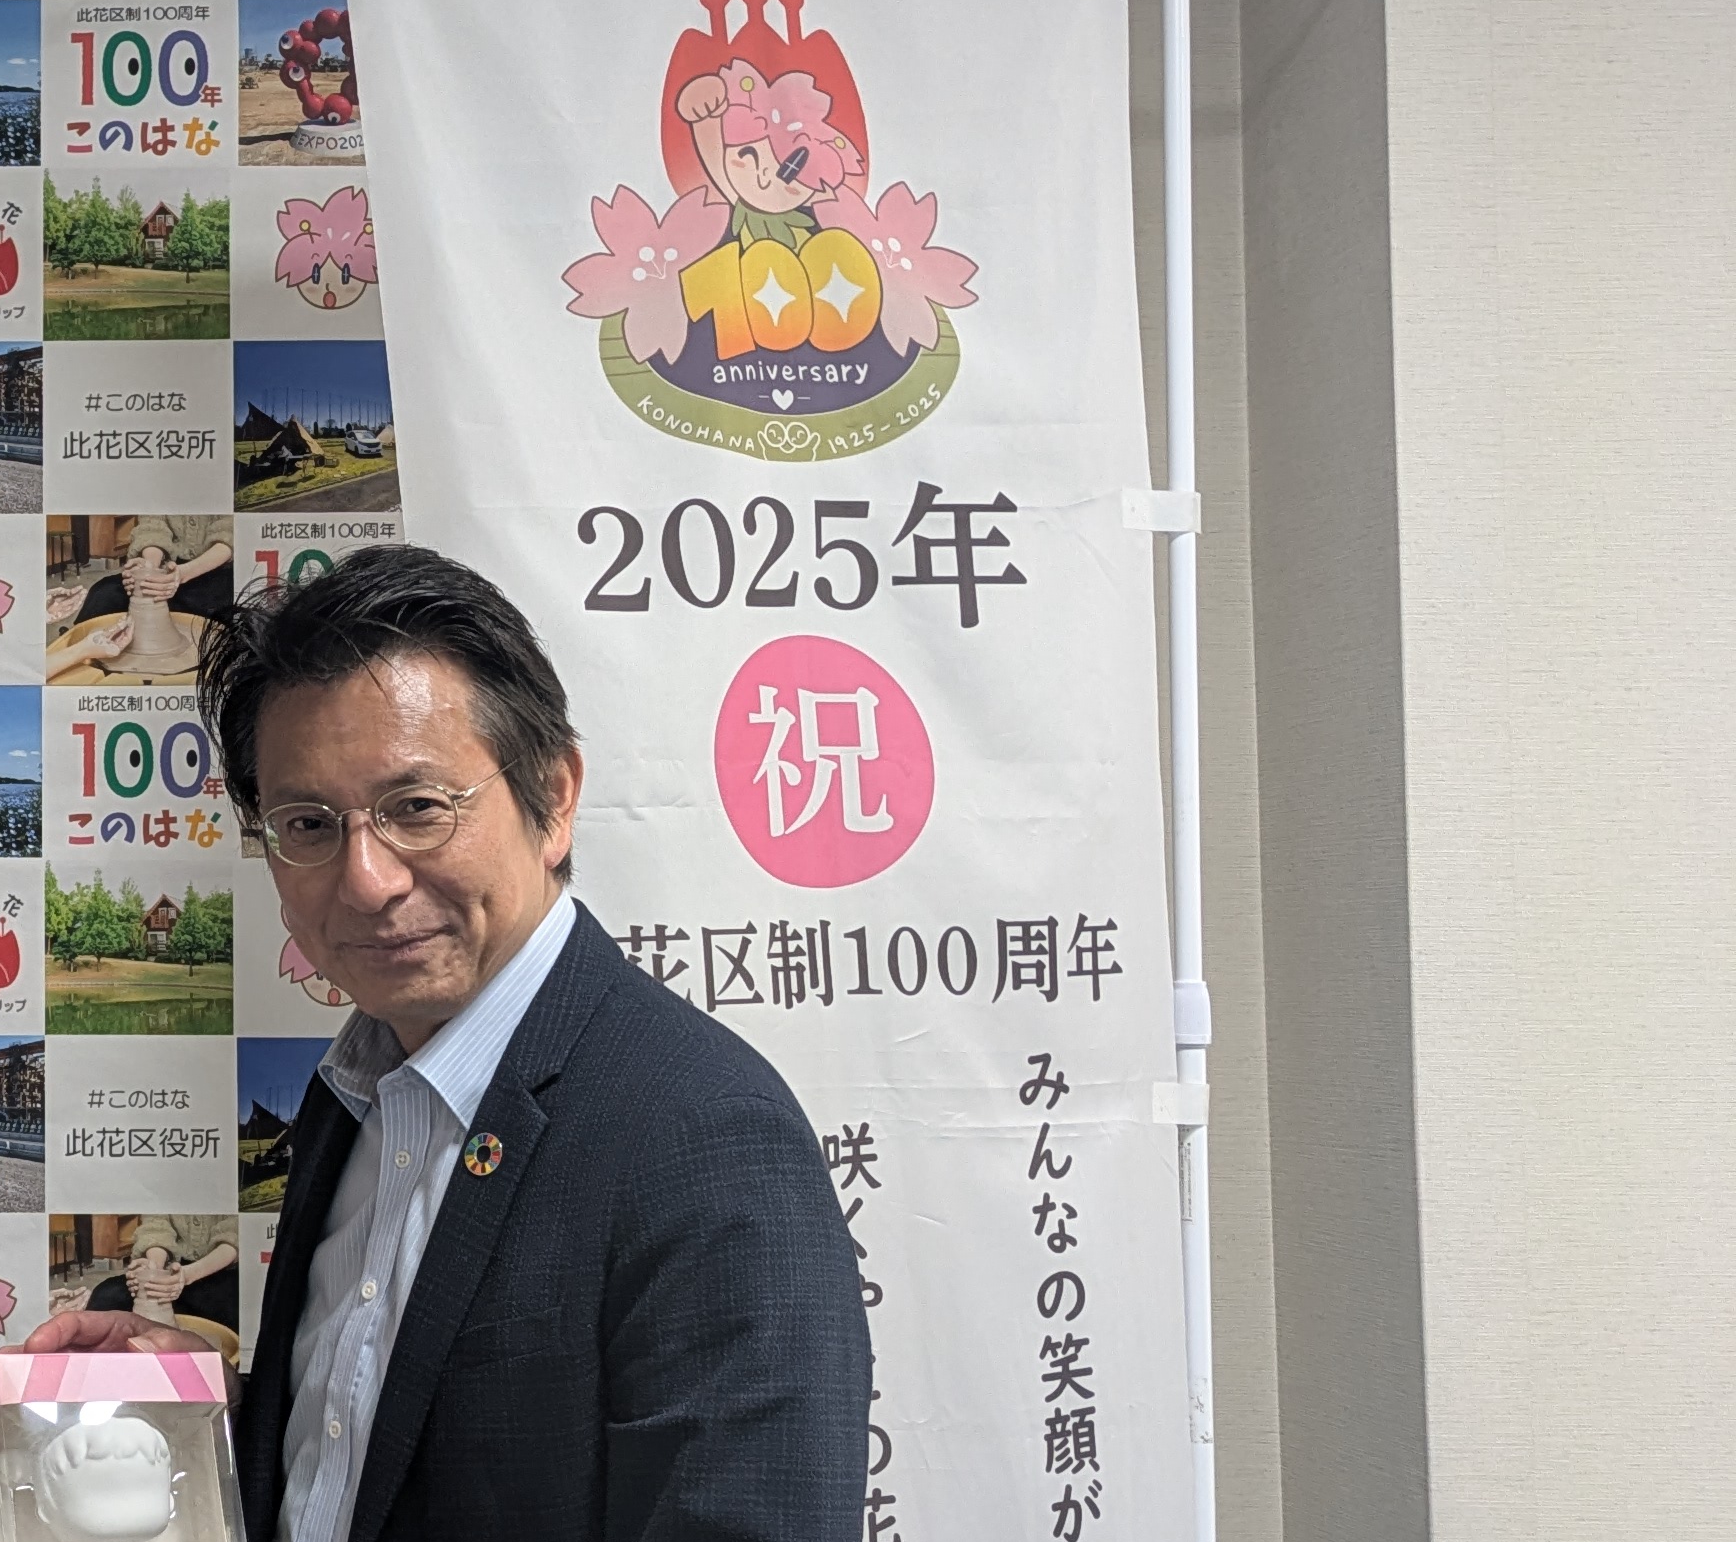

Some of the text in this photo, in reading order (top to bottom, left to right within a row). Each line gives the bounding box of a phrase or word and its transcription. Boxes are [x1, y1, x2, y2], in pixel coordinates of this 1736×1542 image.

[76, 6, 211, 23] 此花区制100周年
[66, 116, 221, 157] このはな
[678, 227, 884, 361] 100
[712, 359, 870, 385] anniversary
[84, 391, 188, 413] #このはな
[637, 394, 756, 451] KONOHANA
[62, 428, 217, 461] 此花区役所
[261, 522, 397, 540] 此花区制100周年
[576, 479, 1029, 629] 2025年
[748, 685, 896, 838] 祝
[68, 809, 224, 848] このはな
[87, 1088, 191, 1110] #このはな
[64, 1127, 221, 1159] 此花区役所
